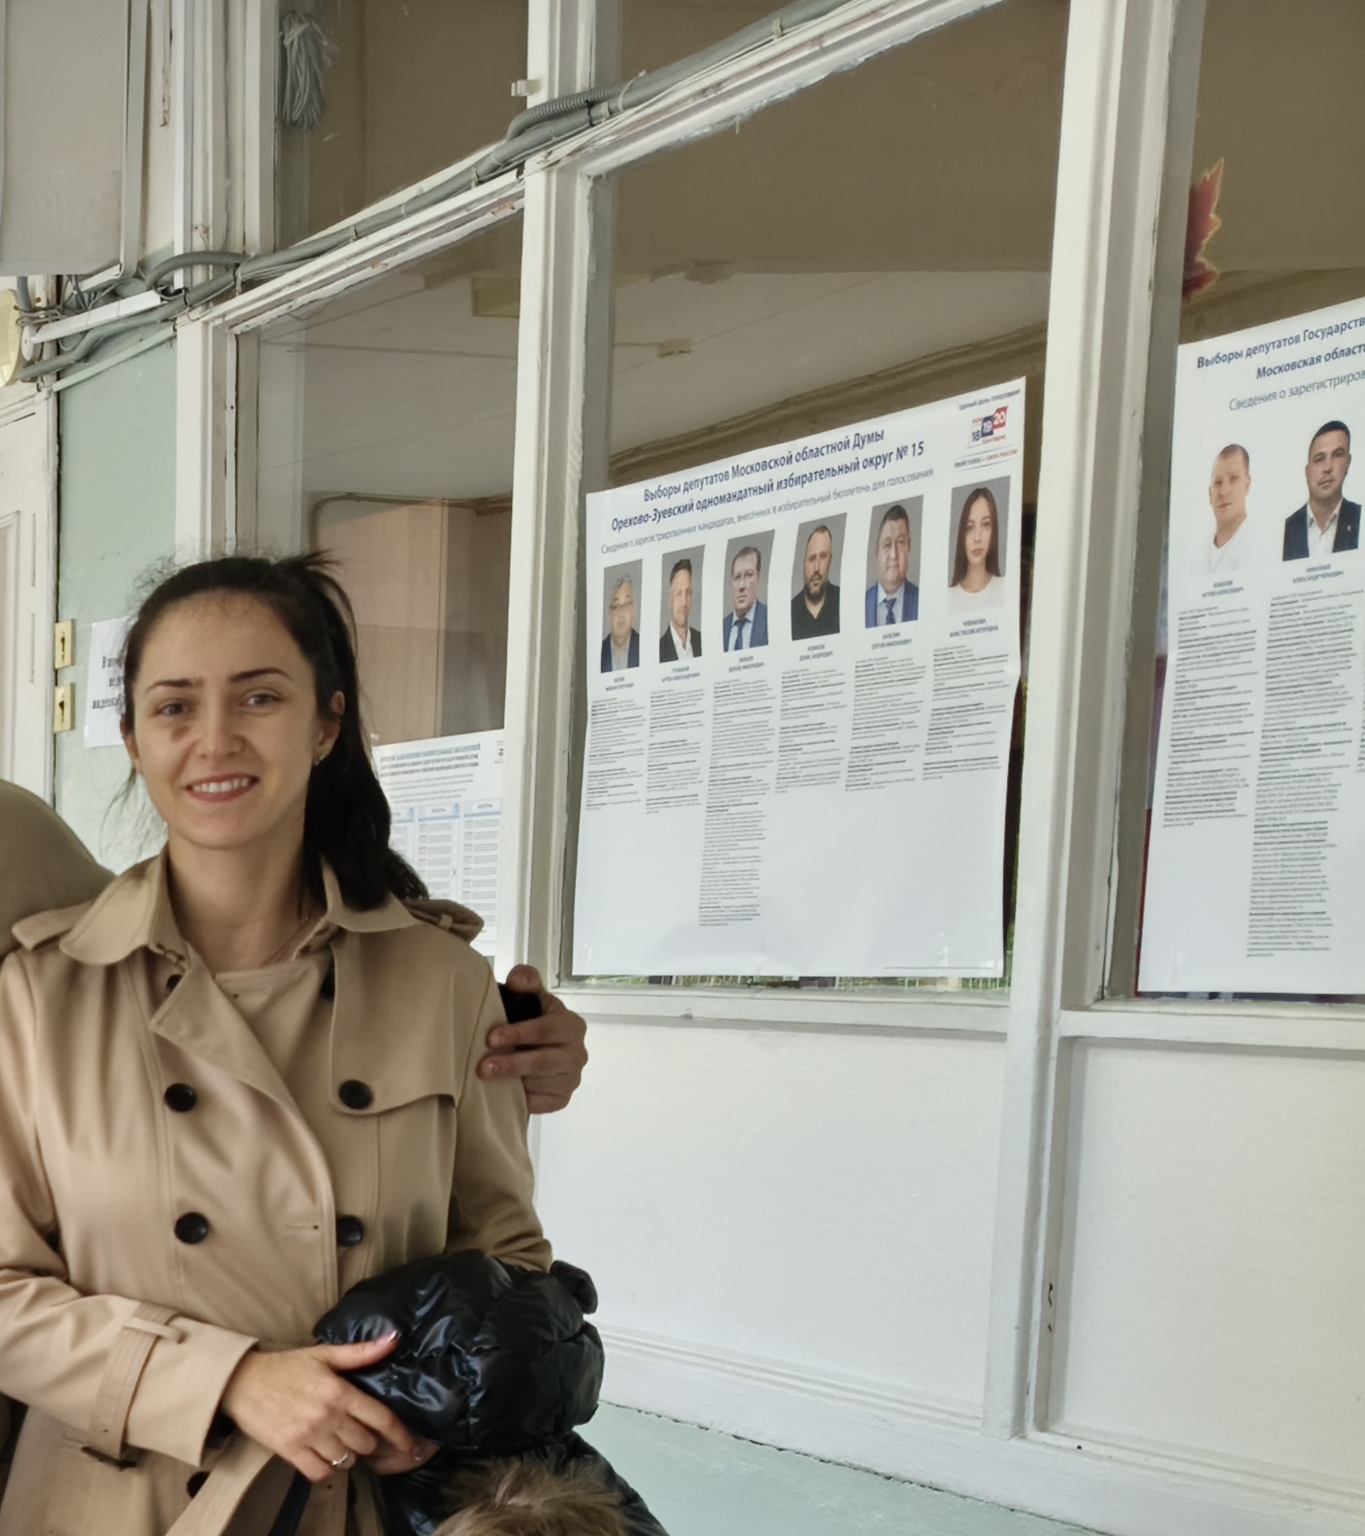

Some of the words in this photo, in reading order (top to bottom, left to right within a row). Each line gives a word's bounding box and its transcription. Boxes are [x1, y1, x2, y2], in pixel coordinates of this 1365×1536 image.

[1197, 349, 1243, 368] Выборы
[1245, 334, 1301, 358] депутатов
[1256, 356, 1322, 379] Московская
[1229, 392, 1277, 411] Сведения
[1279, 390, 1286, 399] о
[993, 411, 1006, 425] 20
[644, 483, 681, 502] Выборы
[682, 472, 730, 495] депутатов
[731, 451, 793, 479] Московской
[794, 436, 850, 464] областной
[853, 429, 884, 450] Думы
[611, 500, 694, 532] Орехово-Зуевский
[696, 477, 773, 511] одномандатный
[776, 457, 860, 491] избирательный
[862, 450, 893, 469] округ
[895, 445, 908, 460] №
[911, 441, 924, 456] 15
[601, 538, 630, 554] Сведения
[872, 479, 885, 492] для
[887, 468, 934, 486] голосования
